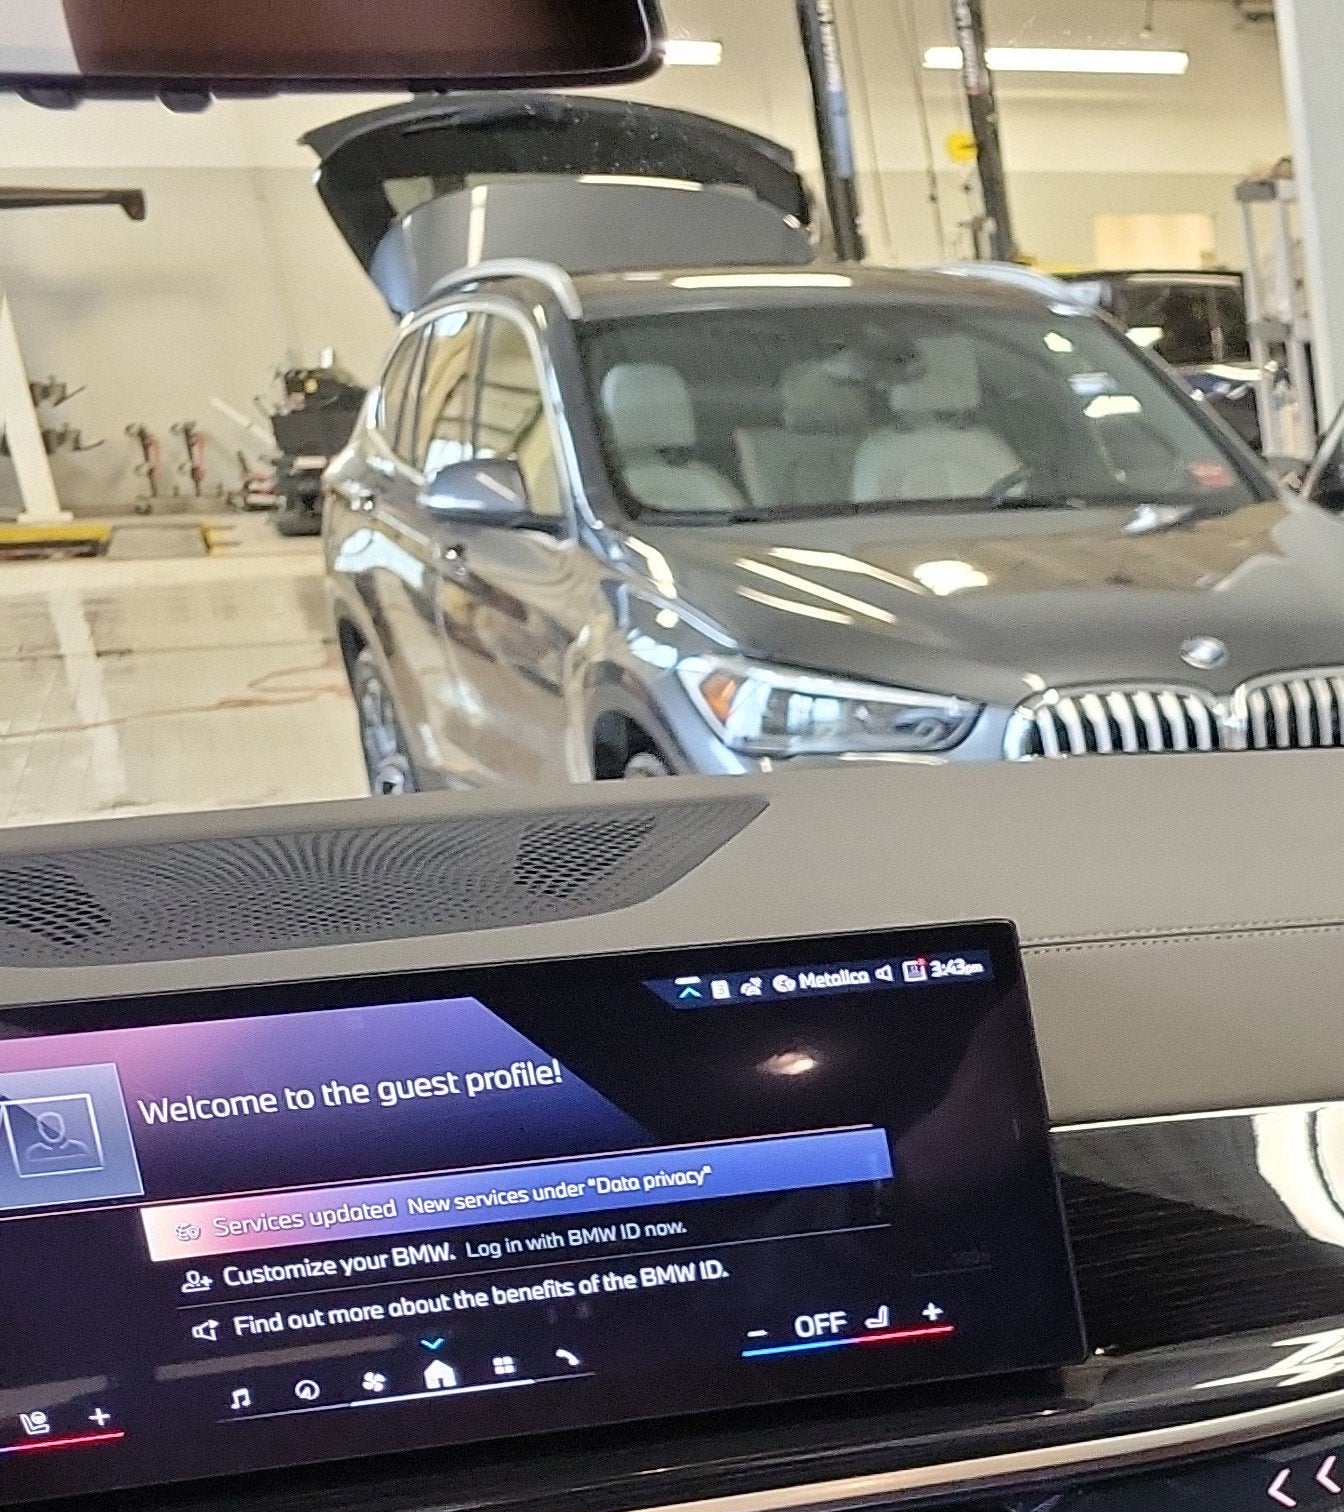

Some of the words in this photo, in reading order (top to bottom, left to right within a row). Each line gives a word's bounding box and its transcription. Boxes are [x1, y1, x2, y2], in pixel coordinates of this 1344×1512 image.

[138, 1093, 278, 1124] Welcome
[285, 1089, 314, 1110] to
[320, 1080, 371, 1107] the
[378, 1071, 461, 1106] guest
[465, 1058, 563, 1098] profile!
[407, 1196, 450, 1215] New
[454, 1187, 529, 1210] services
[533, 1181, 585, 1201] under
[587, 1175, 640, 1195] "Data
[643, 1165, 712, 1192] privacy"
[213, 1212, 304, 1237] Services
[309, 1198, 397, 1228] updated
[465, 1241, 501, 1260] Log
[505, 1237, 523, 1253] in
[525, 1231, 565, 1250] with
[568, 1225, 616, 1246] BMW
[620, 1222, 641, 1241] ID
[645, 1220, 688, 1238] now.
[223, 1257, 337, 1286] Customize
[340, 1253, 388, 1276] your
[392, 1242, 457, 1267] BMW.
[233, 1312, 283, 1336] Find
[288, 1309, 326, 1330] out
[328, 1302, 384, 1325] more
[388, 1294, 451, 1318] about
[452, 1289, 489, 1309] the
[491, 1279, 574, 1305] benefits
[578, 1273, 600, 1293] of
[603, 1271, 637, 1291] the
[639, 1262, 696, 1287] BMW
[699, 1259, 730, 1280] ID.
[794, 1310, 847, 1338] OFF
